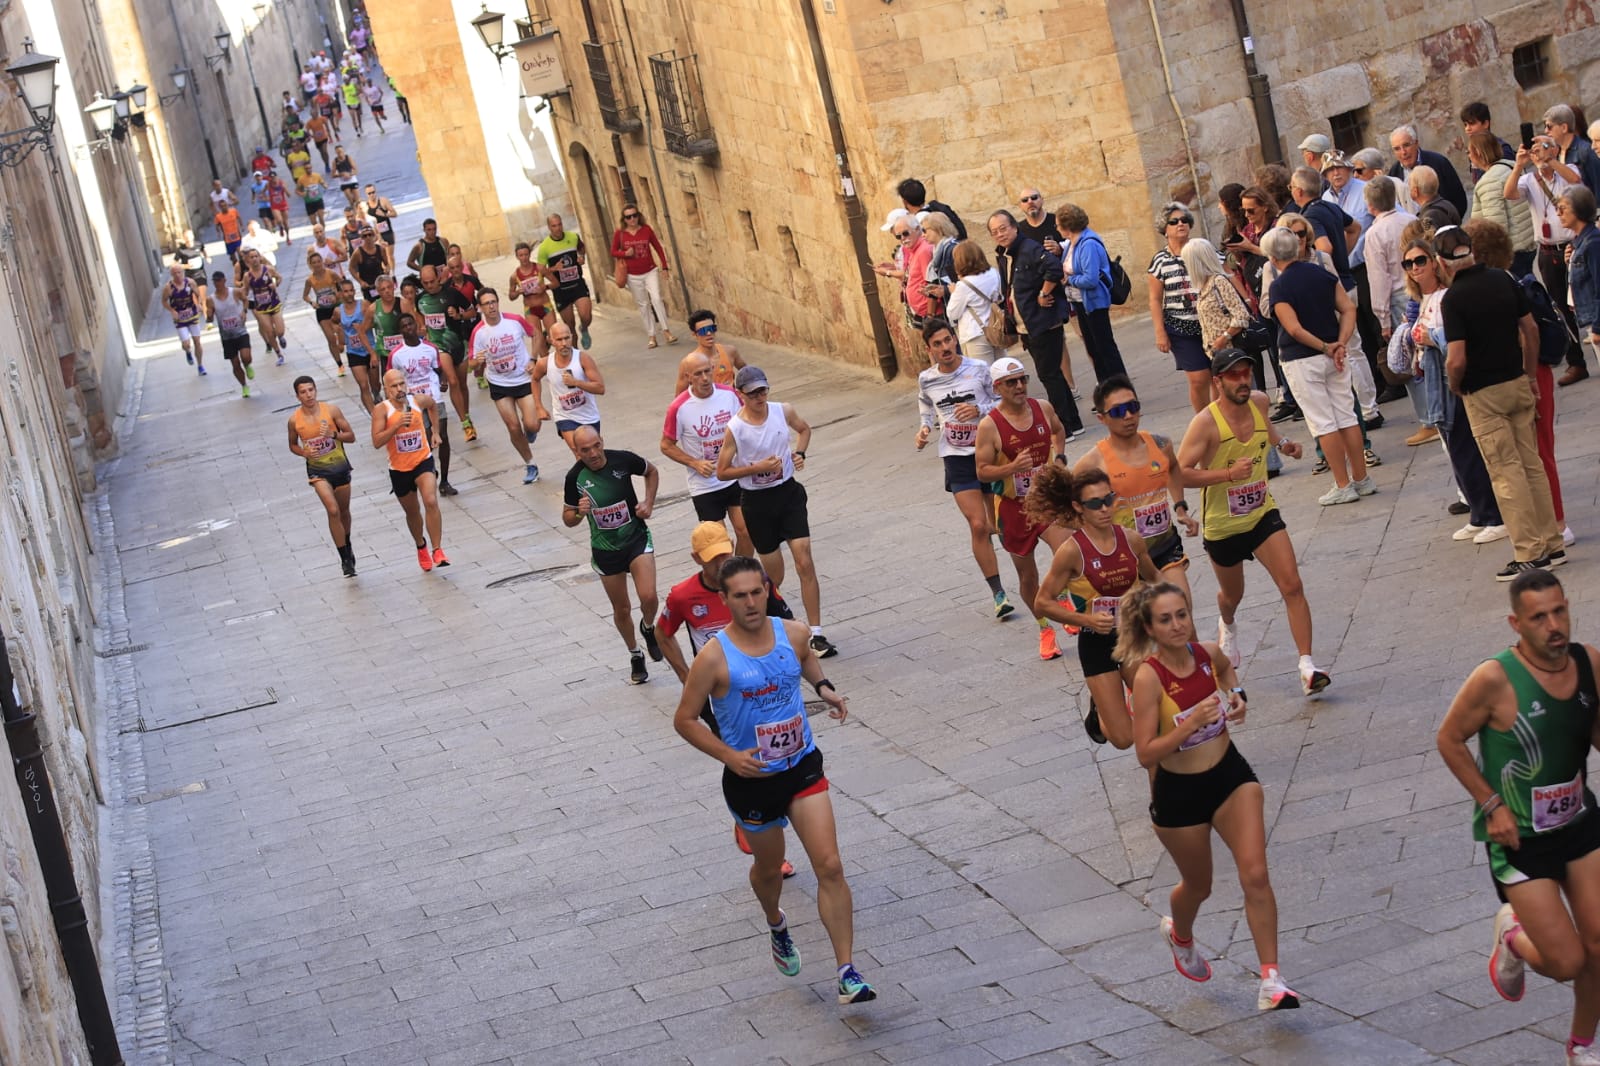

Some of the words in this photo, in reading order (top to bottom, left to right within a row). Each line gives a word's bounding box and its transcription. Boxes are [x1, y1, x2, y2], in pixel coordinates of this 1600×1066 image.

[402, 437, 418, 447] 187
[950, 430, 971, 441] 337
[1238, 490, 1261, 506] 353
[602, 511, 622, 523] 478
[1145, 510, 1168, 527] 481
[770, 729, 797, 748] 421
